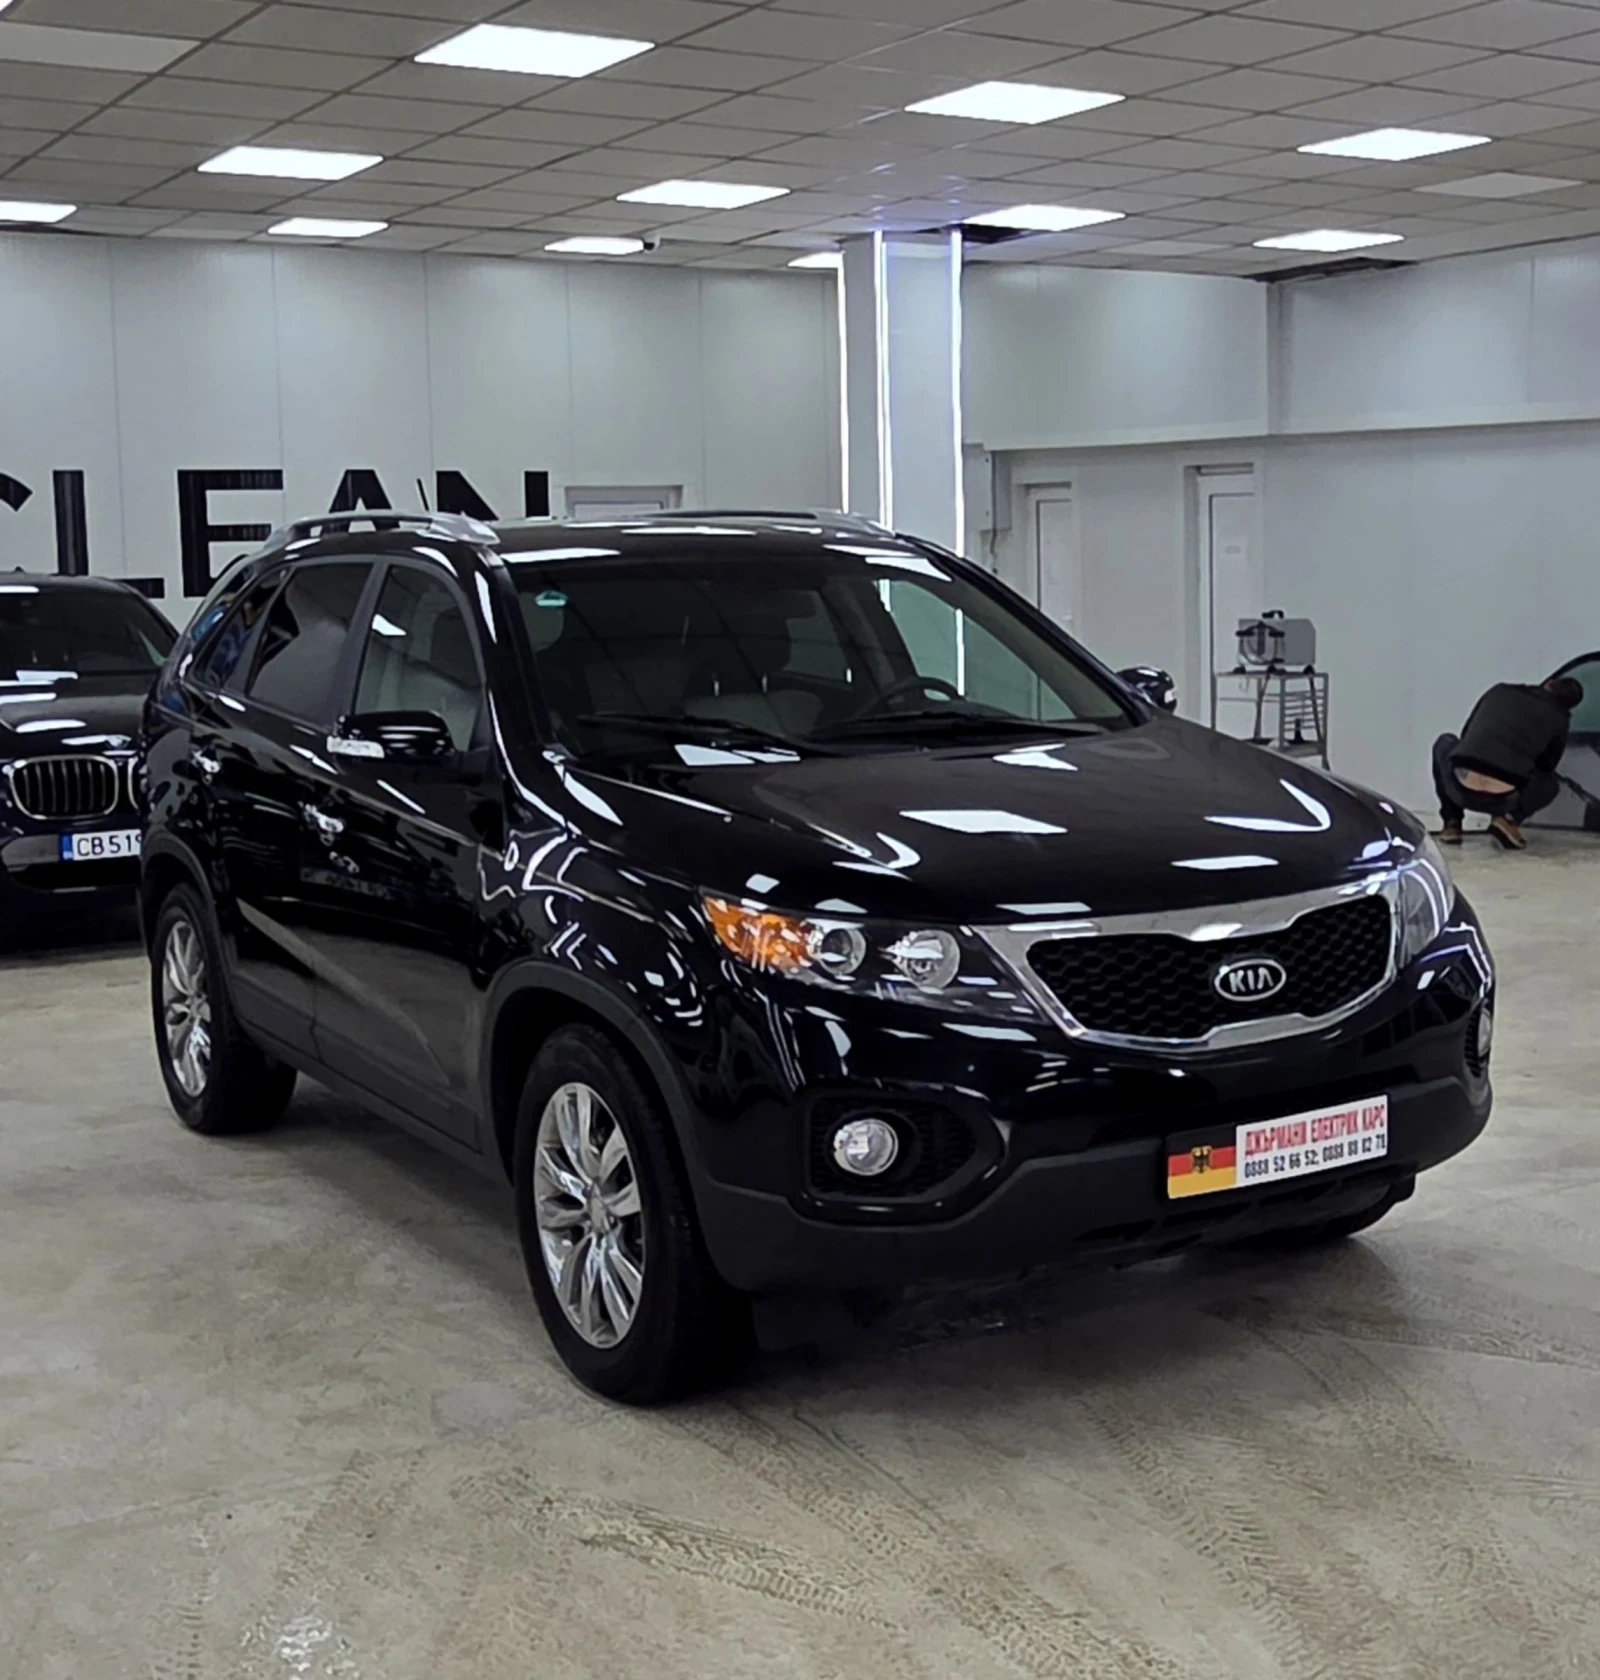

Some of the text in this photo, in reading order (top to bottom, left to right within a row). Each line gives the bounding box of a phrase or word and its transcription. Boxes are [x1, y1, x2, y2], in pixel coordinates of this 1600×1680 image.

[0, 468, 550, 598] LEA
[77, 836, 104, 857] CB
[1228, 966, 1274, 993] KIA
